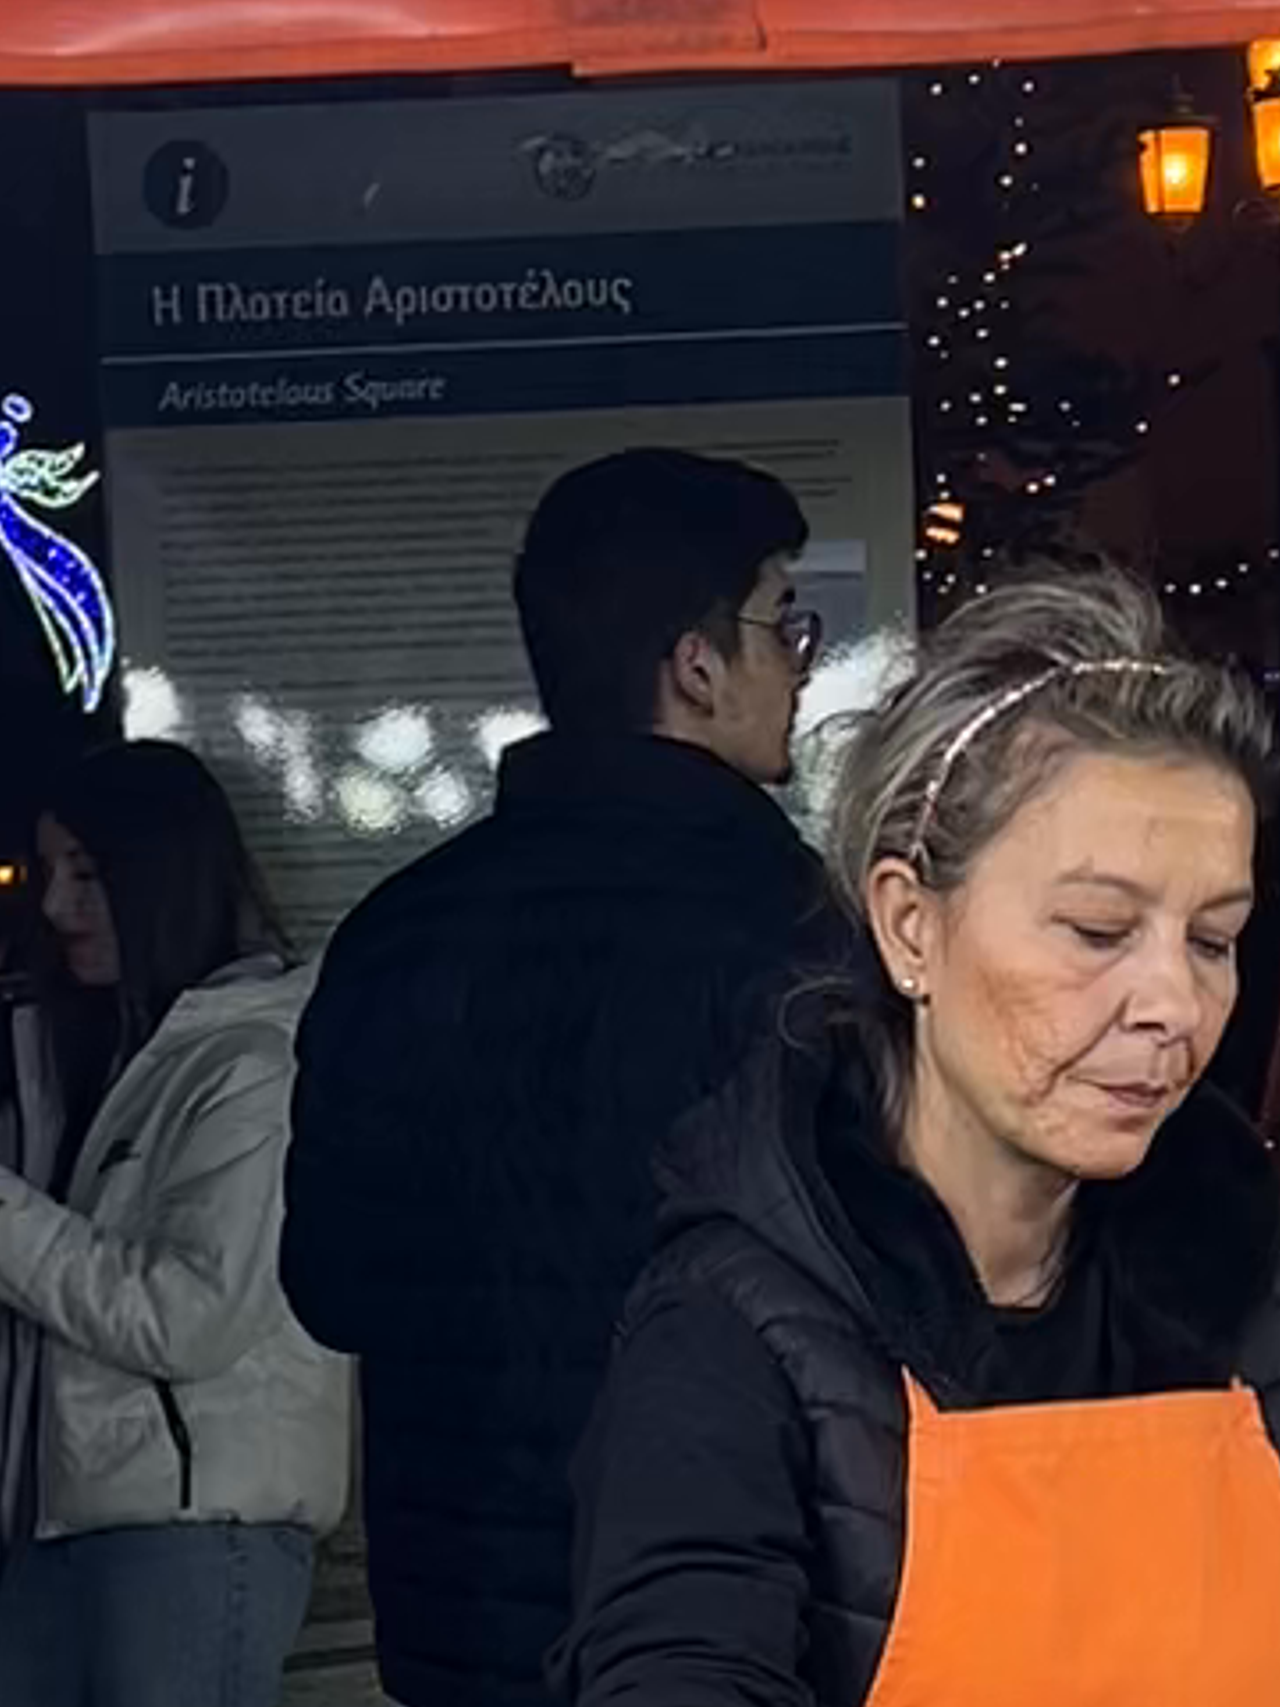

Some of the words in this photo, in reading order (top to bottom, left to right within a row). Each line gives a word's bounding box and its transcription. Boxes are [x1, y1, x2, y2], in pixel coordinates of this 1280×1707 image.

[152, 285, 182, 327] Η
[196, 281, 350, 323] Πλατεία
[365, 269, 633, 325] Αριστοτέλους
[158, 379, 335, 412] Aristotelous
[344, 371, 446, 409] Square
